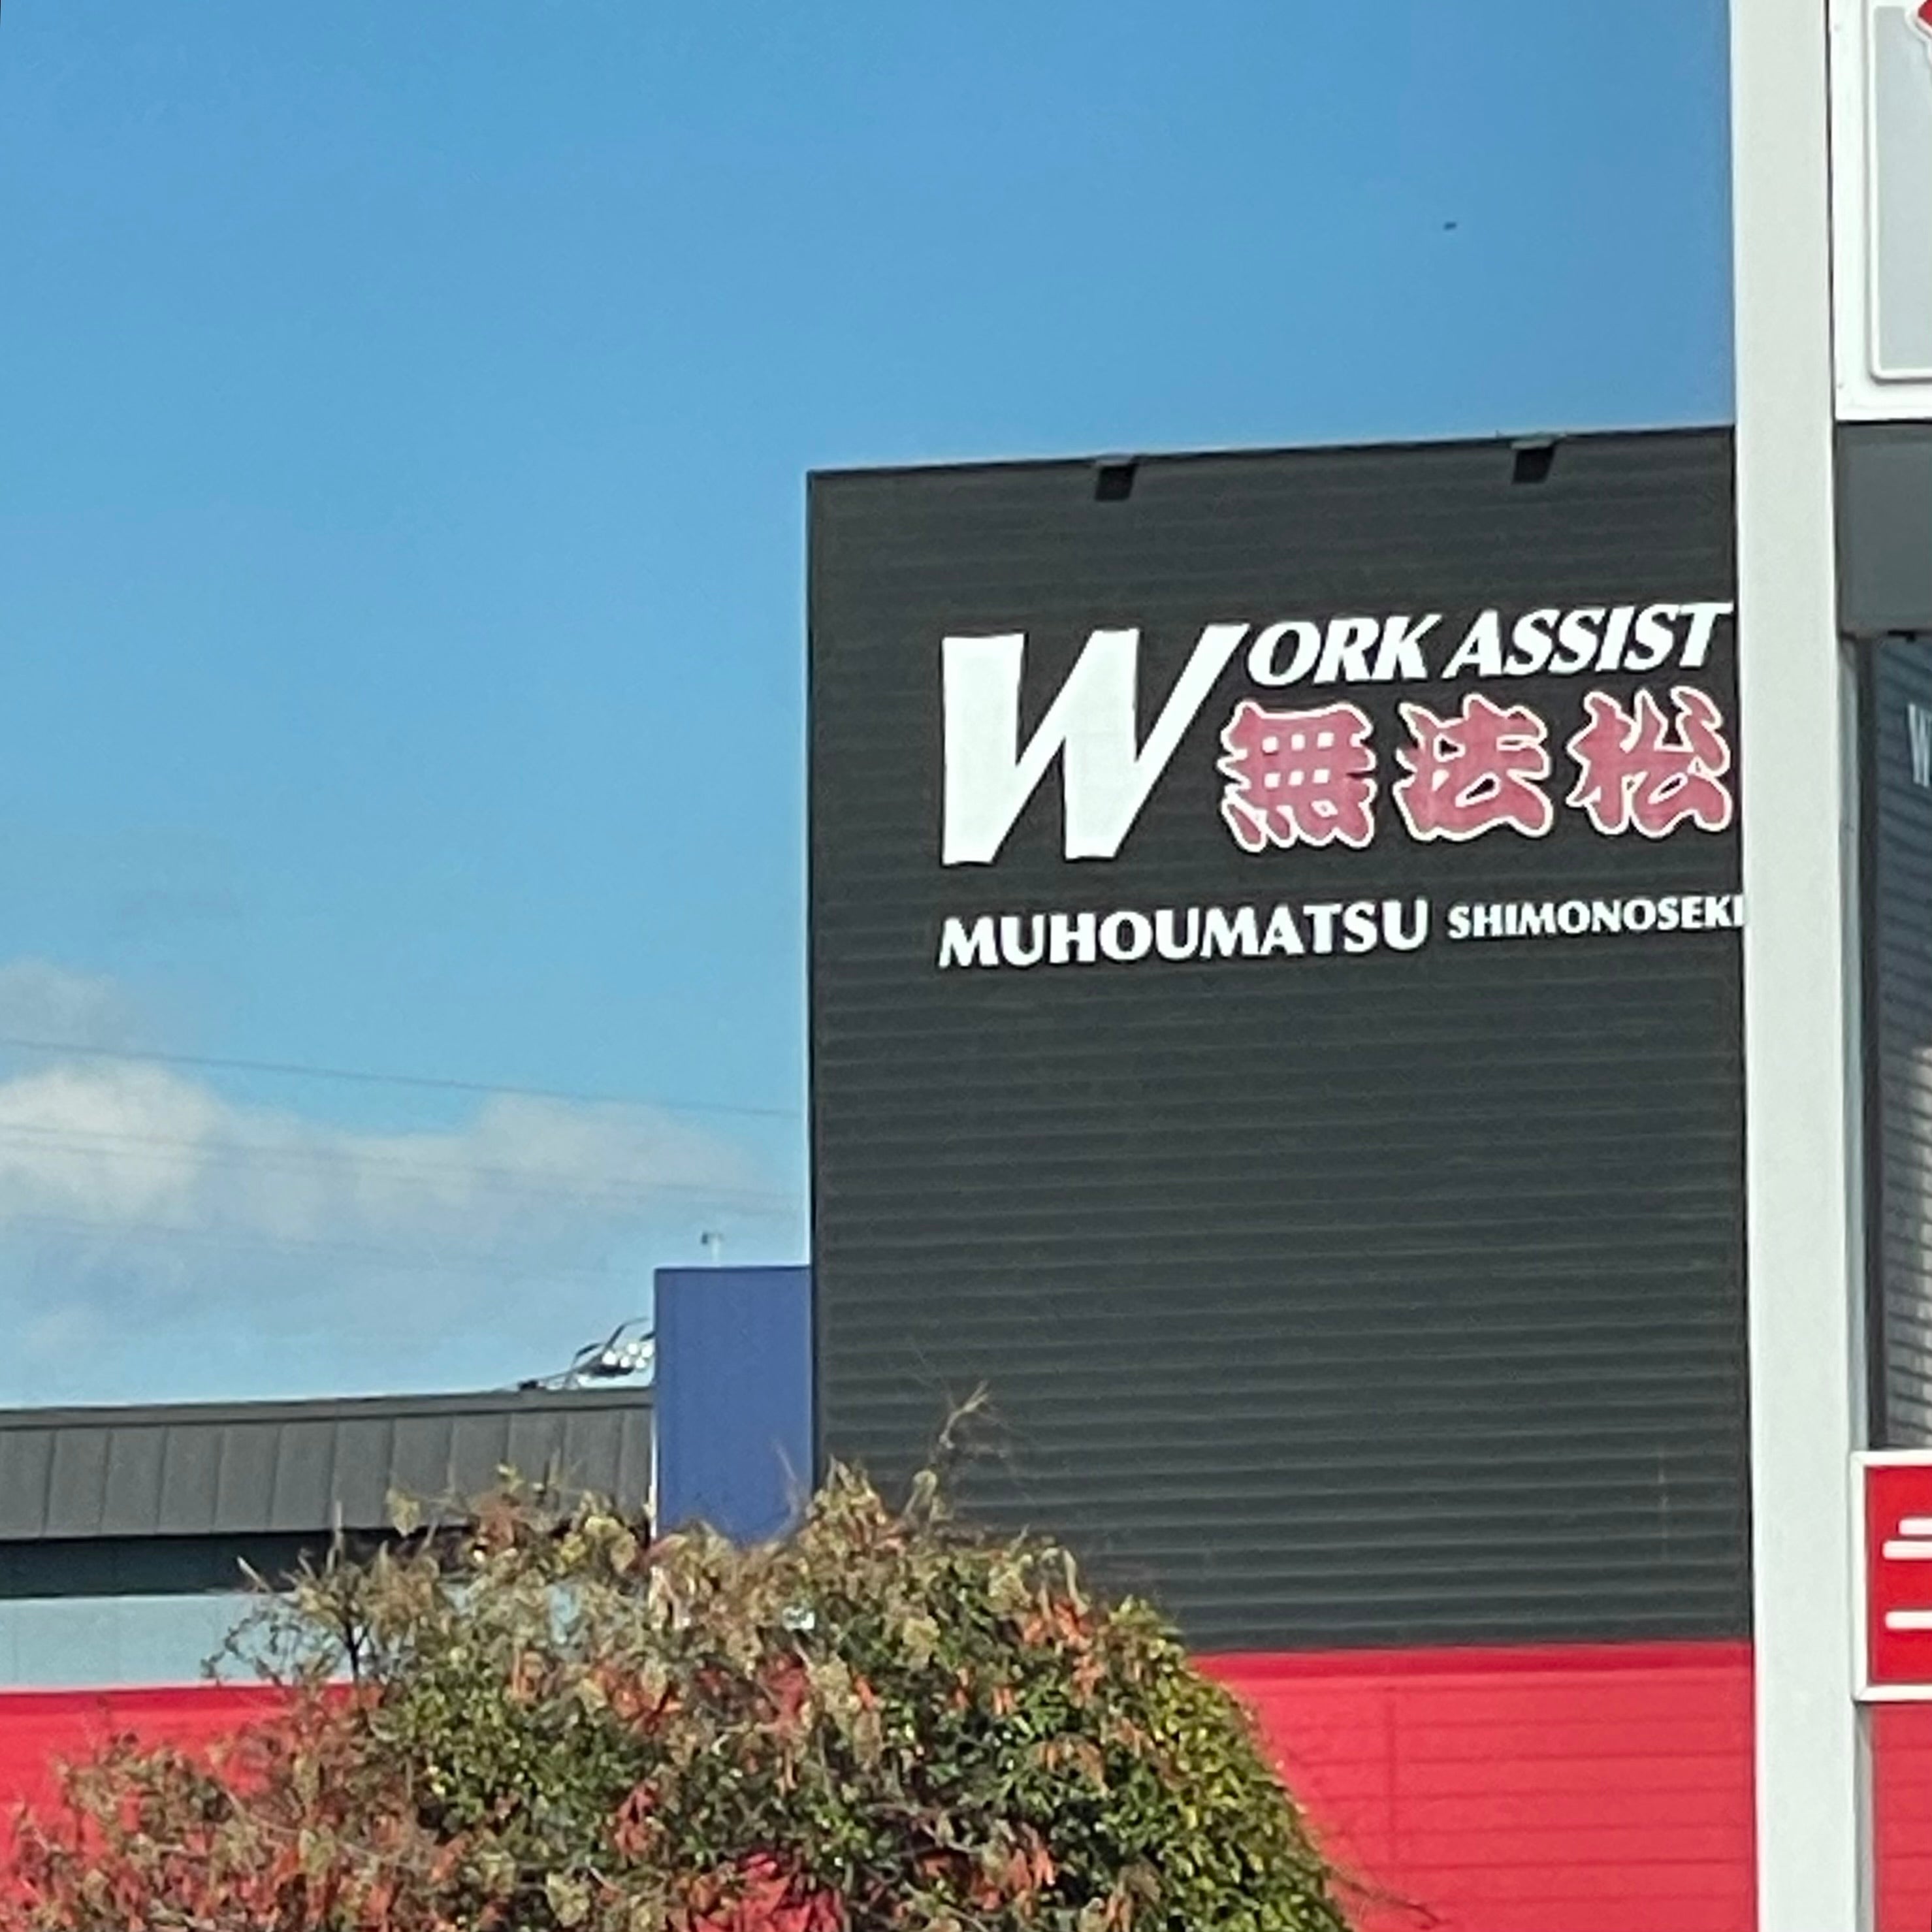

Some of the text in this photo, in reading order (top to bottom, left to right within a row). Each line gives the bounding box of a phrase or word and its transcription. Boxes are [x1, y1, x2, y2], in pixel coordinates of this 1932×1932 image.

[1441, 602, 1734, 679] ASSIST
[1216, 684, 1734, 853] 無法松
[938, 894, 1745, 968] MUHOUMATSU SHIMONOSEKI
